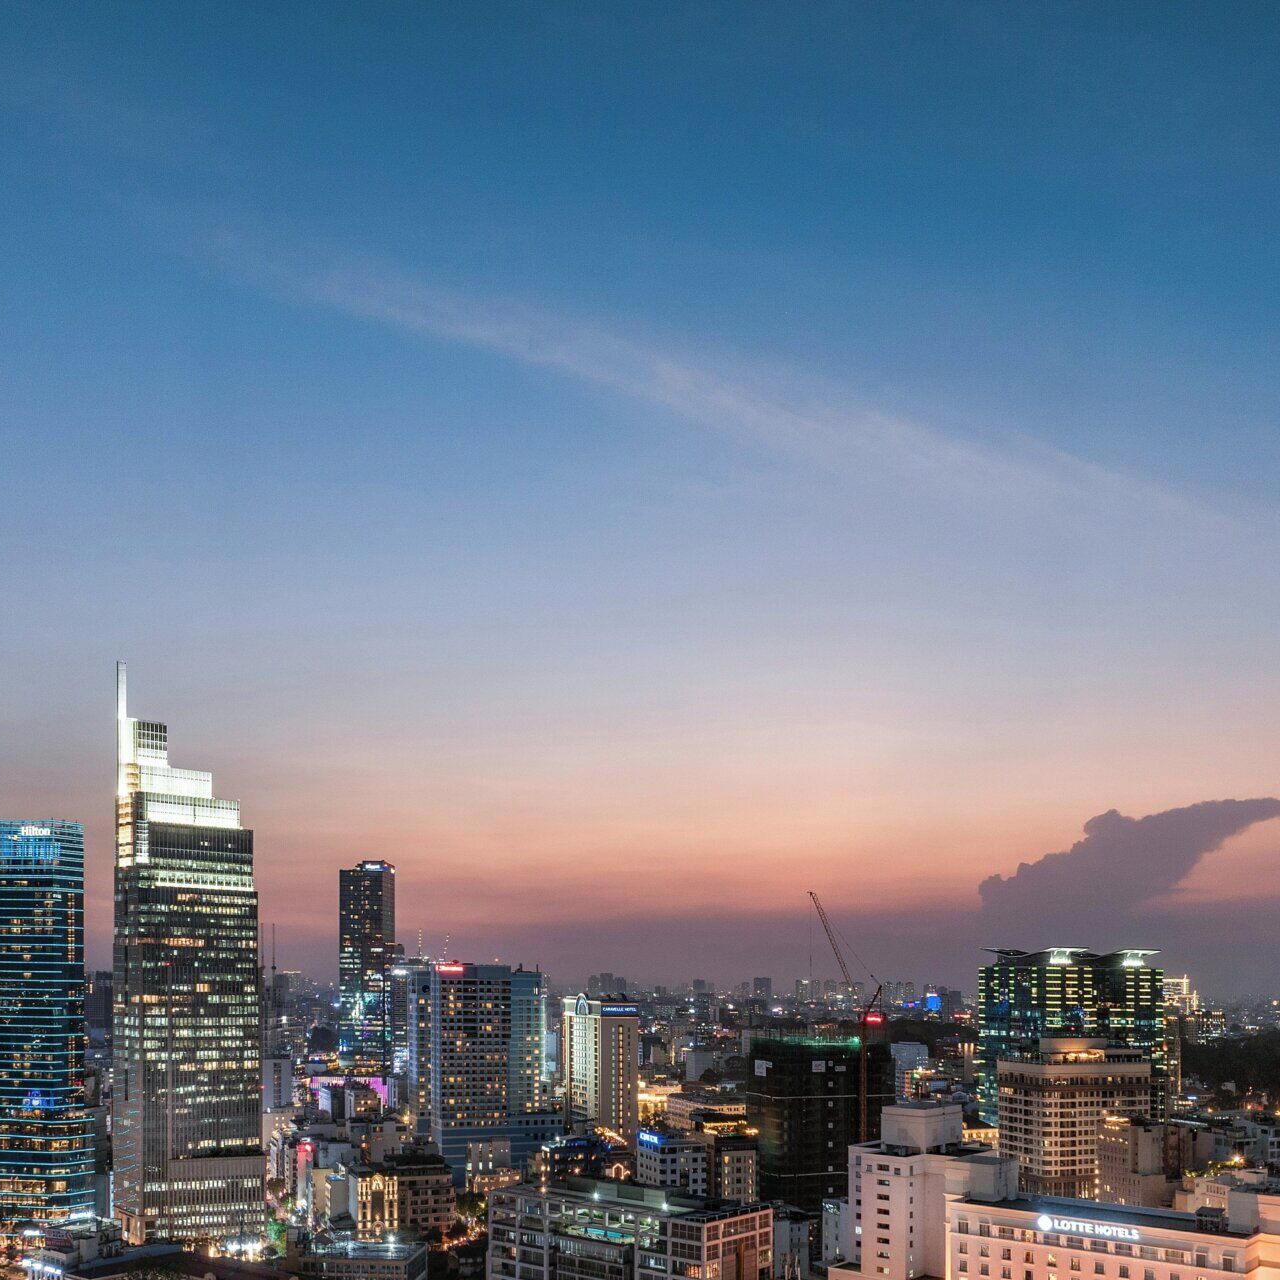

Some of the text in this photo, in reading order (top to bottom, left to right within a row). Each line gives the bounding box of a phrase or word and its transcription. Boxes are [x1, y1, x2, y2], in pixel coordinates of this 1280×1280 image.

[21, 826, 51, 836] Hilton
[1053, 1218, 1140, 1240] LOTTE HOTELS
